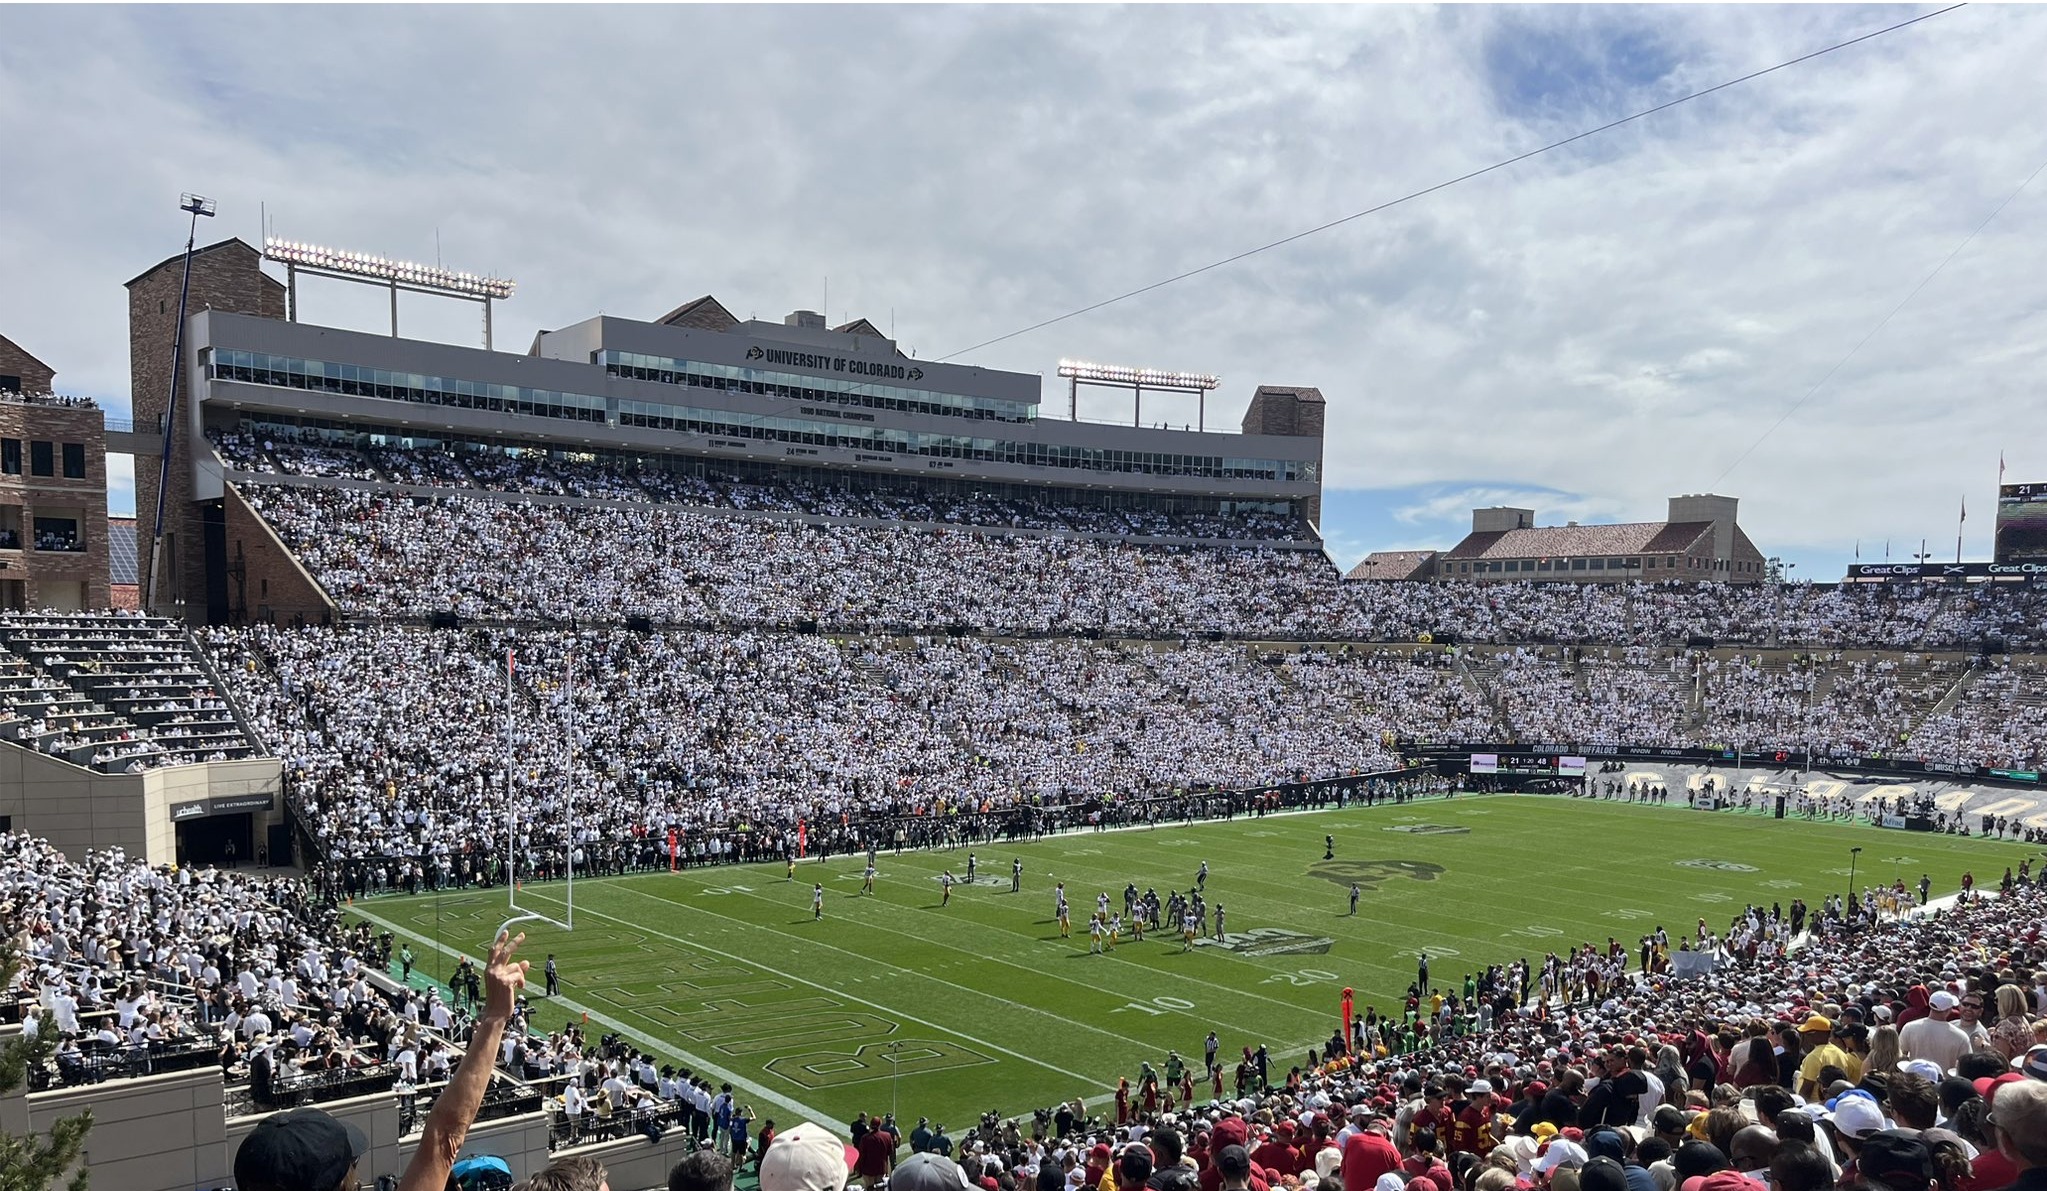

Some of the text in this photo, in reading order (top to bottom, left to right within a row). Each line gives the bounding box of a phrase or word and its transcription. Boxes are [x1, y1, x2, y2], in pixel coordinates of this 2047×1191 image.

[766, 348, 831, 370] UNIVERSITY
[833, 357, 846, 372] OF
[849, 359, 905, 380] COLORADO
[786, 447, 795, 455] 24
[2018, 485, 2031, 494] 21
[1860, 565, 1918, 576] Great Clips
[1988, 563, 2047, 574] Great Clips
[1532, 744, 1618, 755] COLORADO BUFFALOES
[1537, 757, 1547, 765] 48
[226, 799, 270, 808] EXTRAORDINARY
[1270, 968, 1340, 987] 20
[1125, 996, 1196, 1017] 10
